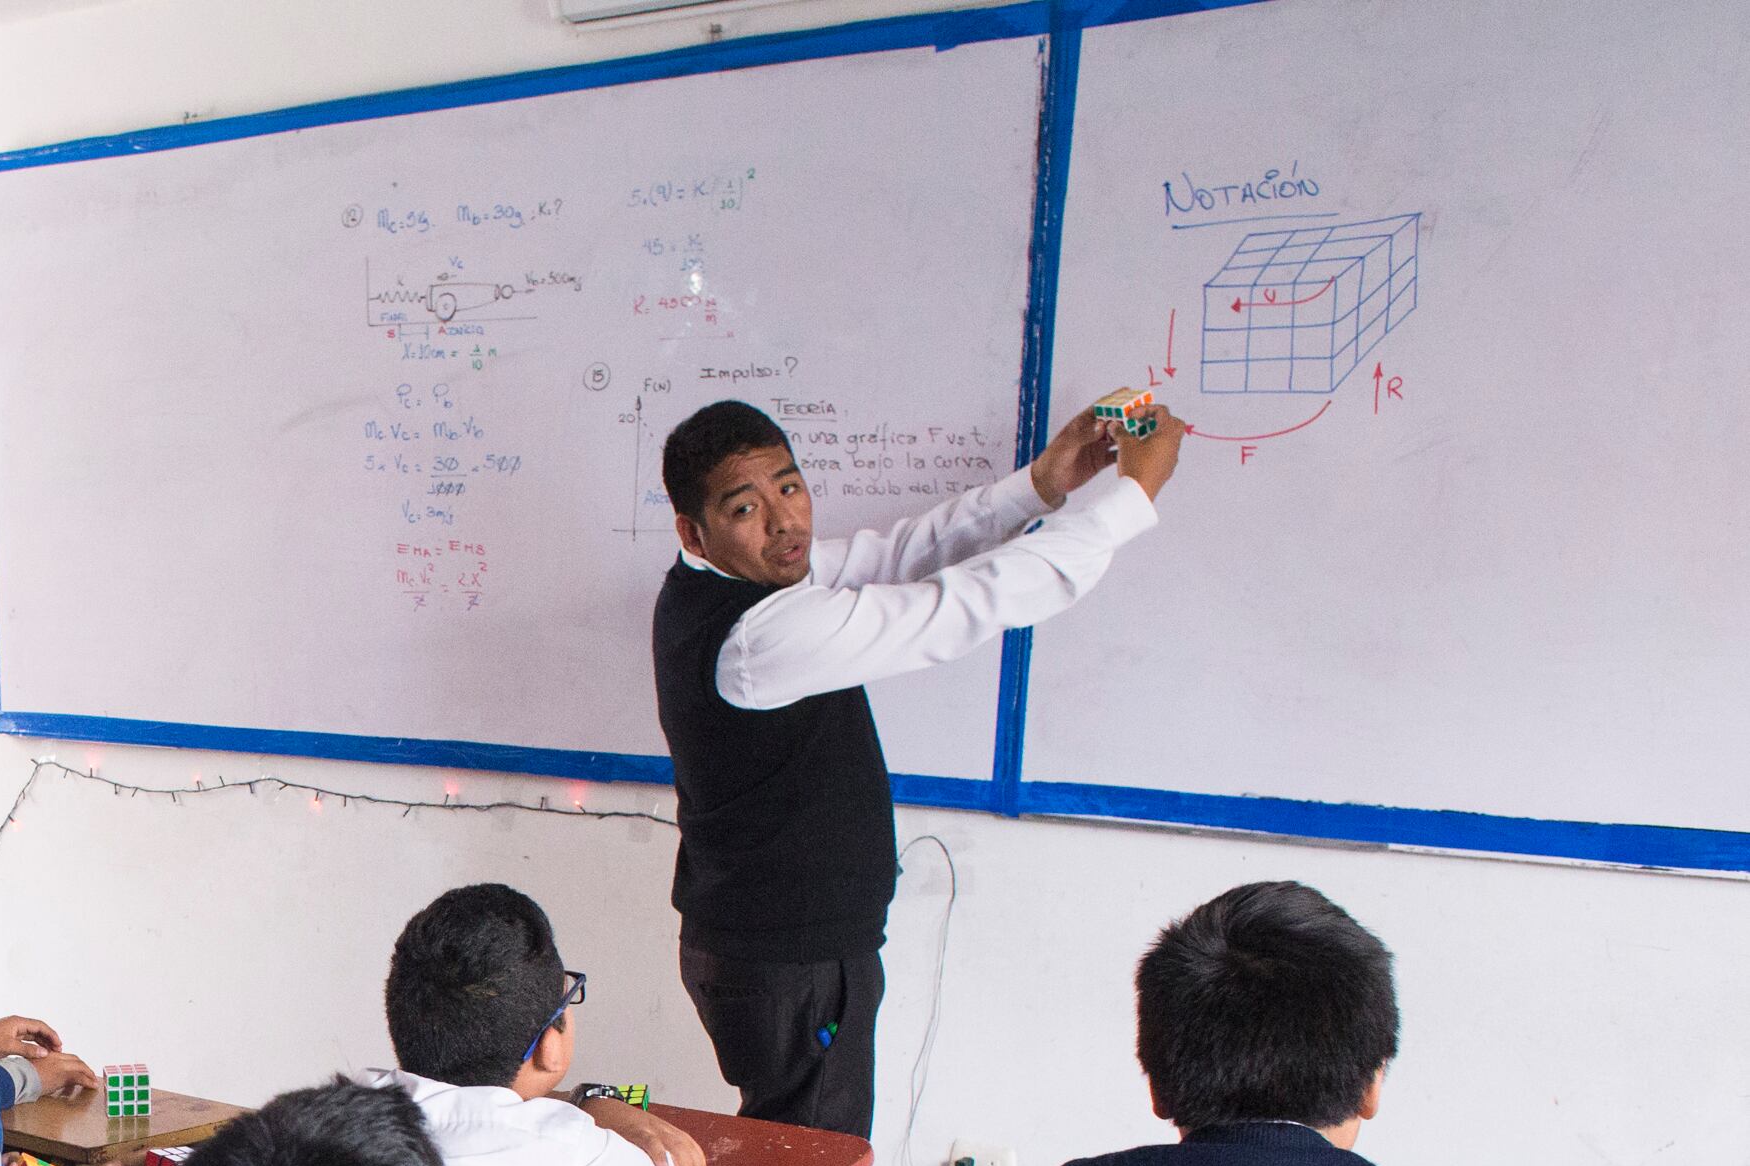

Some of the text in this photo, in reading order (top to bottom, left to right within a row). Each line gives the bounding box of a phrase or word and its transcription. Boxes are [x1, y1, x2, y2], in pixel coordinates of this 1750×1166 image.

[1164, 160, 1320, 216] NOTACIÓN
[1264, 289, 1277, 304] U
[1148, 365, 1162, 386] L
[1387, 376, 1403, 400] R
[618, 413, 635, 423] 20
[809, 432, 838, 445] una
[847, 422, 917, 454] gráfica
[1241, 446, 1257, 465] F
[800, 453, 994, 481] área bajo la curva
[812, 480, 828, 498] el
[909, 480, 939, 495] del
